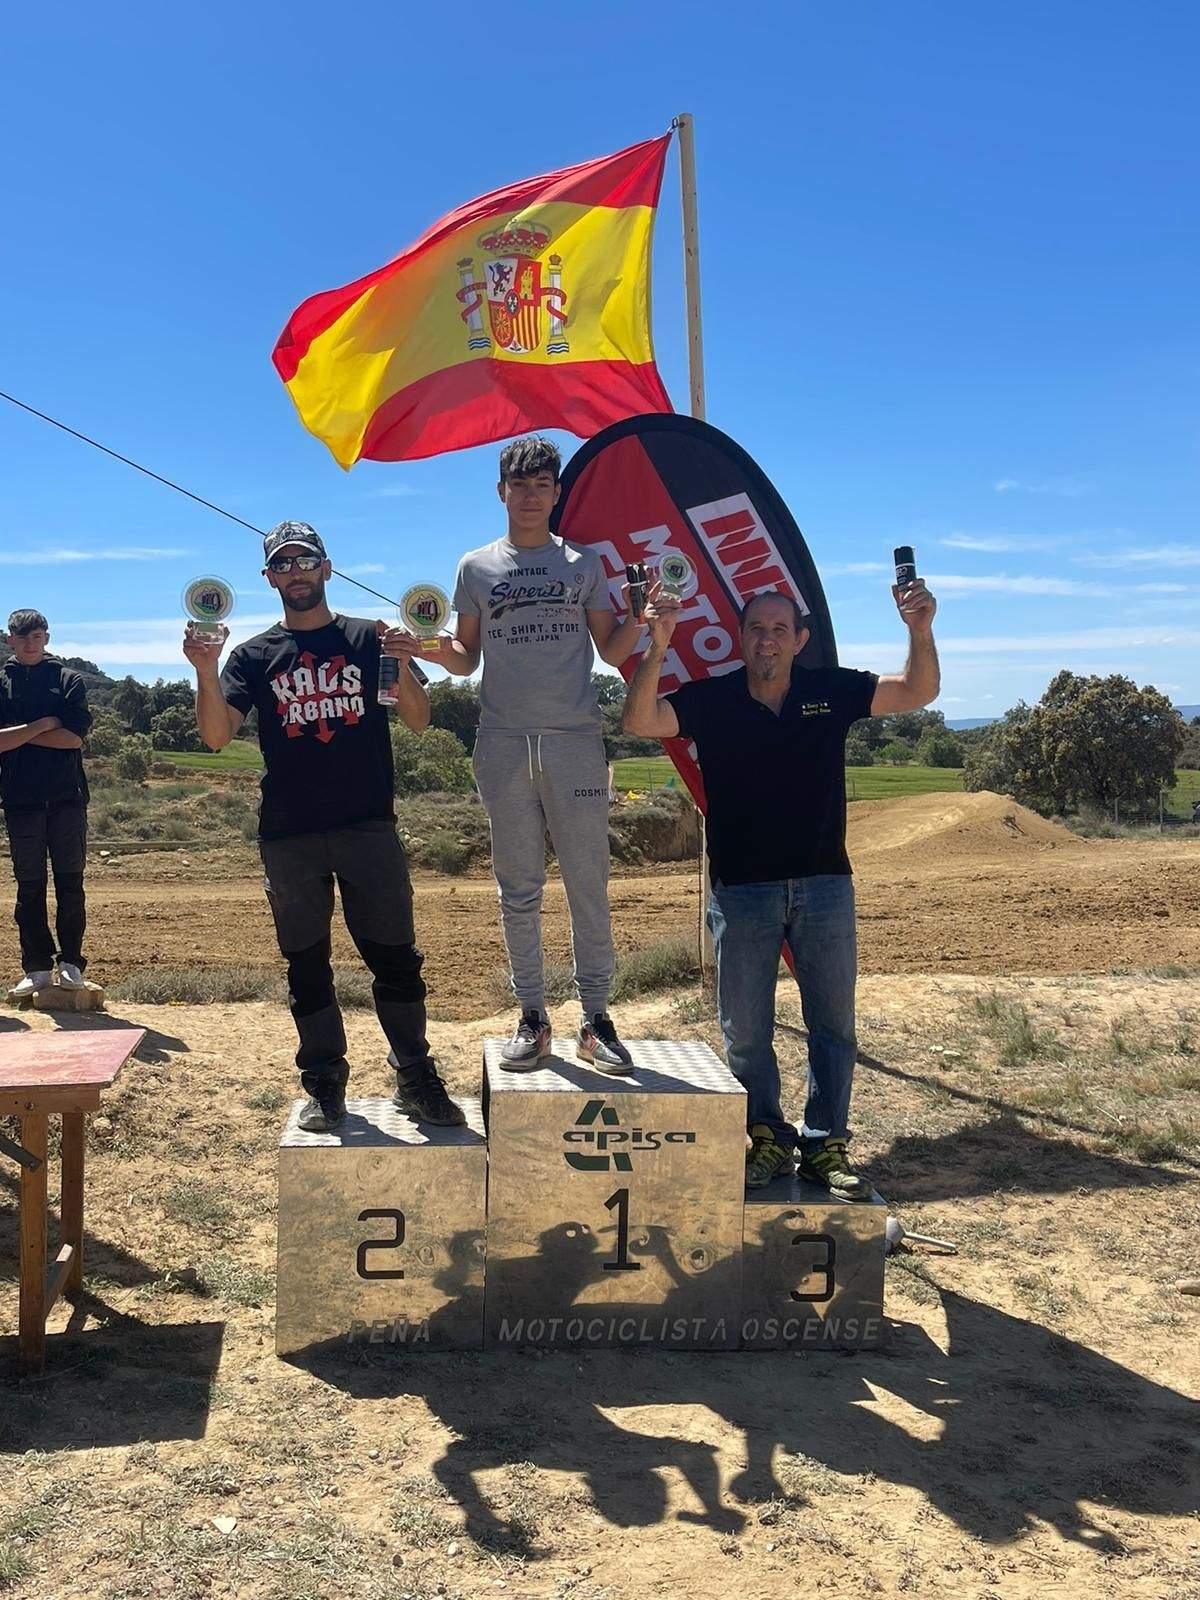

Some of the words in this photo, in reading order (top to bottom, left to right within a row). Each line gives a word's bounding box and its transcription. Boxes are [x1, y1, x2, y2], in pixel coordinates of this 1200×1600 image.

[507, 567, 548, 578] VINTAGE
[552, 623, 579, 633] STORE
[563, 1127, 696, 1150] apisa
[356, 1208, 406, 1280] 2
[603, 1188, 641, 1271] 1
[790, 1233, 836, 1303] 3
[347, 1313, 431, 1344] PEÑA
[499, 1318, 727, 1342] MOTOCICLISTA
[741, 1318, 881, 1341] OSCENSE
